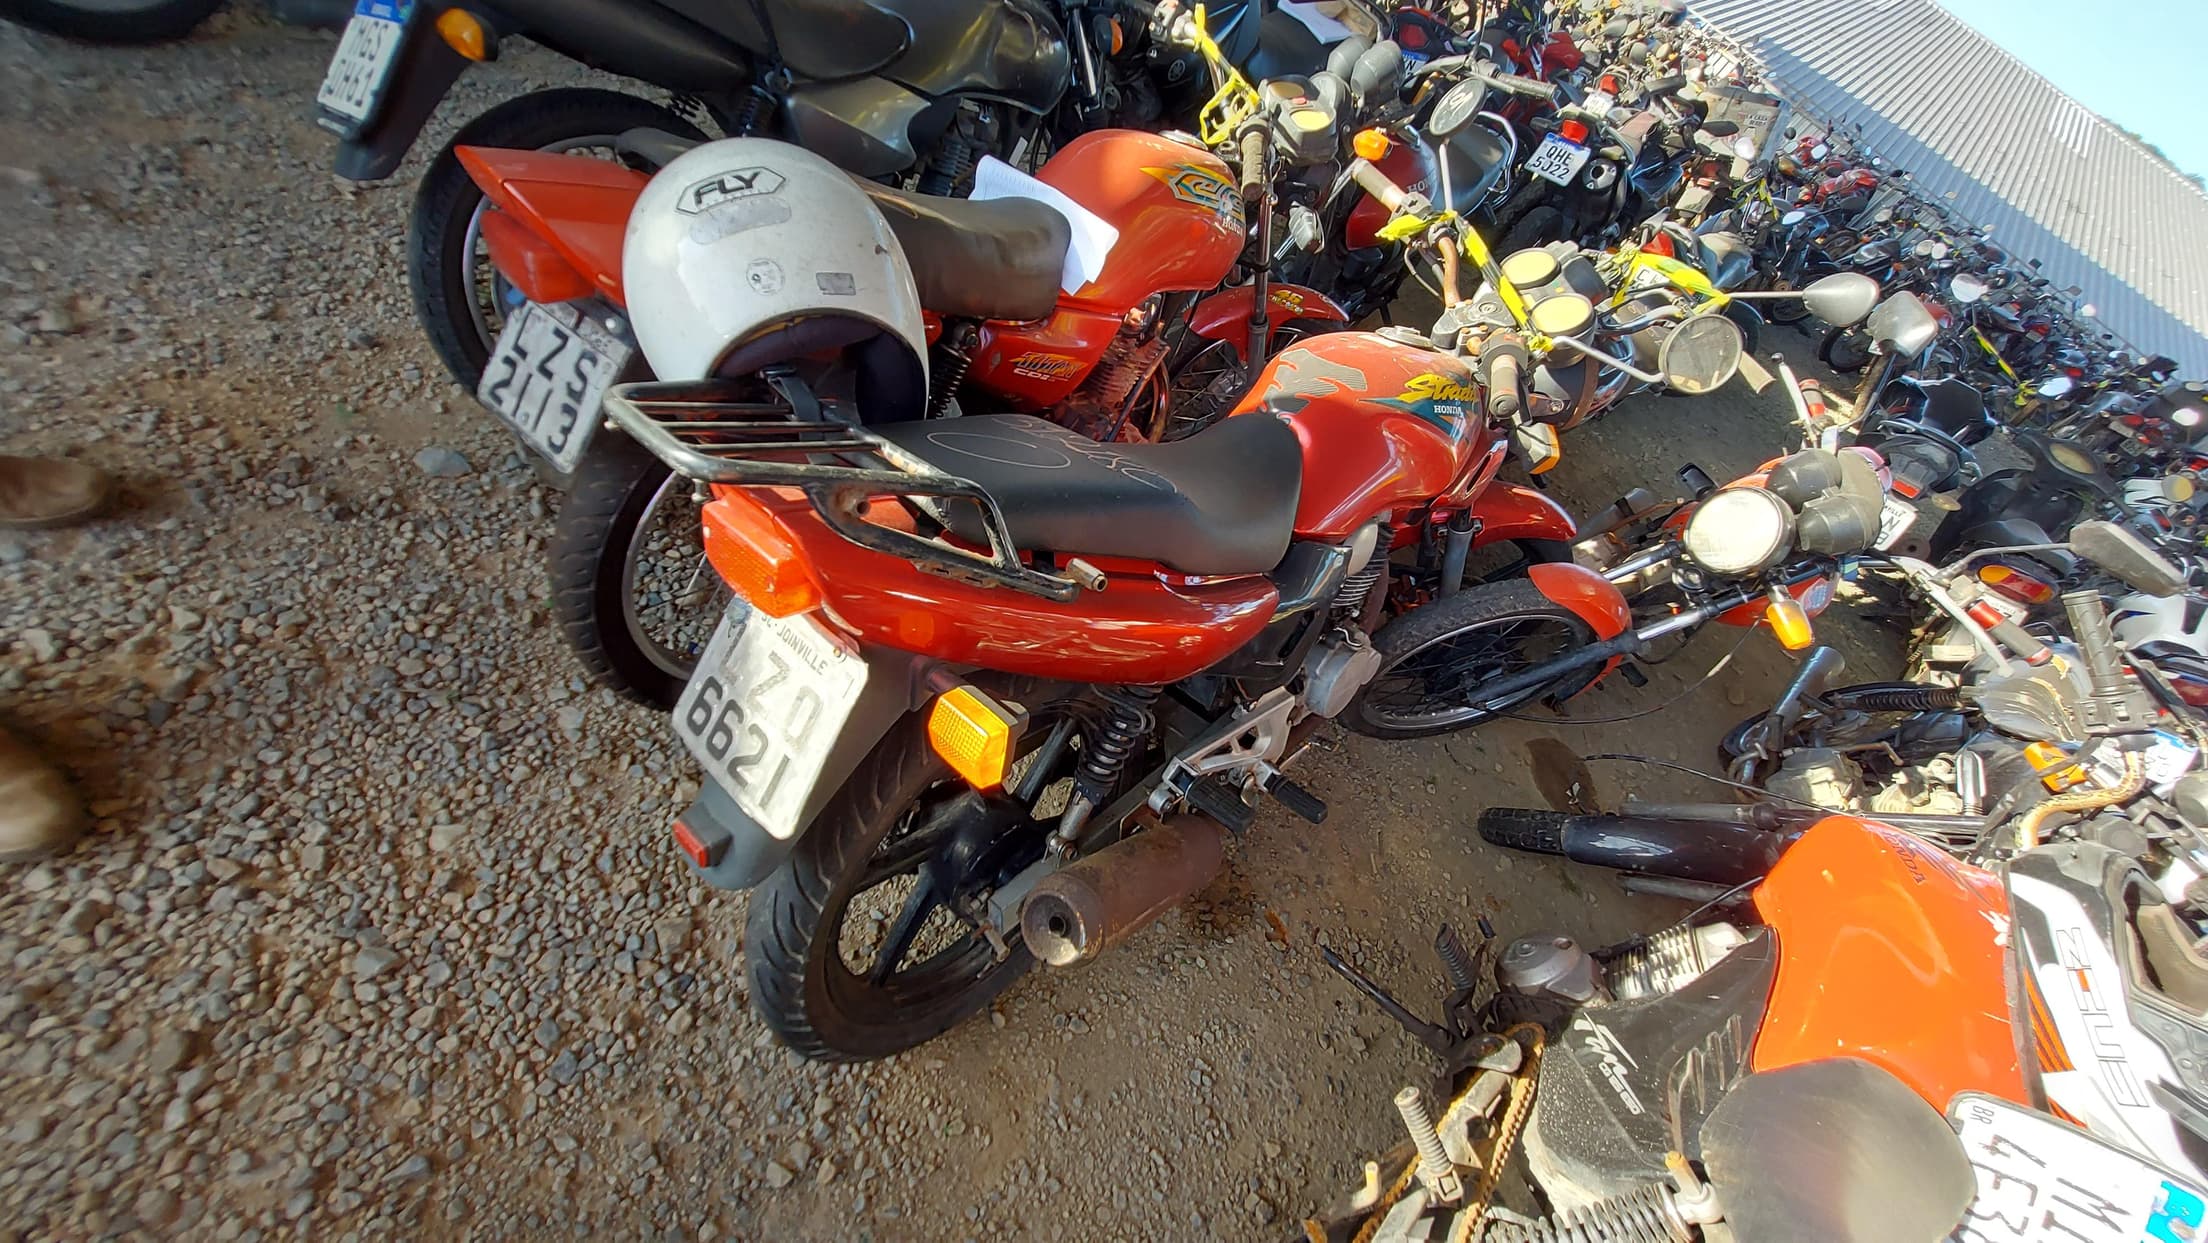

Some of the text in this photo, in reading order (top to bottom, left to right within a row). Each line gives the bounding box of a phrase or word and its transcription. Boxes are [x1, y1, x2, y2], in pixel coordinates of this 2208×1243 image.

[1532, 156, 1570, 180] 5J22
[1546, 145, 1575, 167] QHE
[694, 171, 761, 205] FLY
[512, 306, 598, 405] LZS
[488, 354, 578, 454] 2113
[1433, 404, 1464, 416] HONDA
[776, 621, 829, 676] JOINVILLE
[686, 675, 791, 811] 6621
[1969, 1105, 1996, 1125] BR
